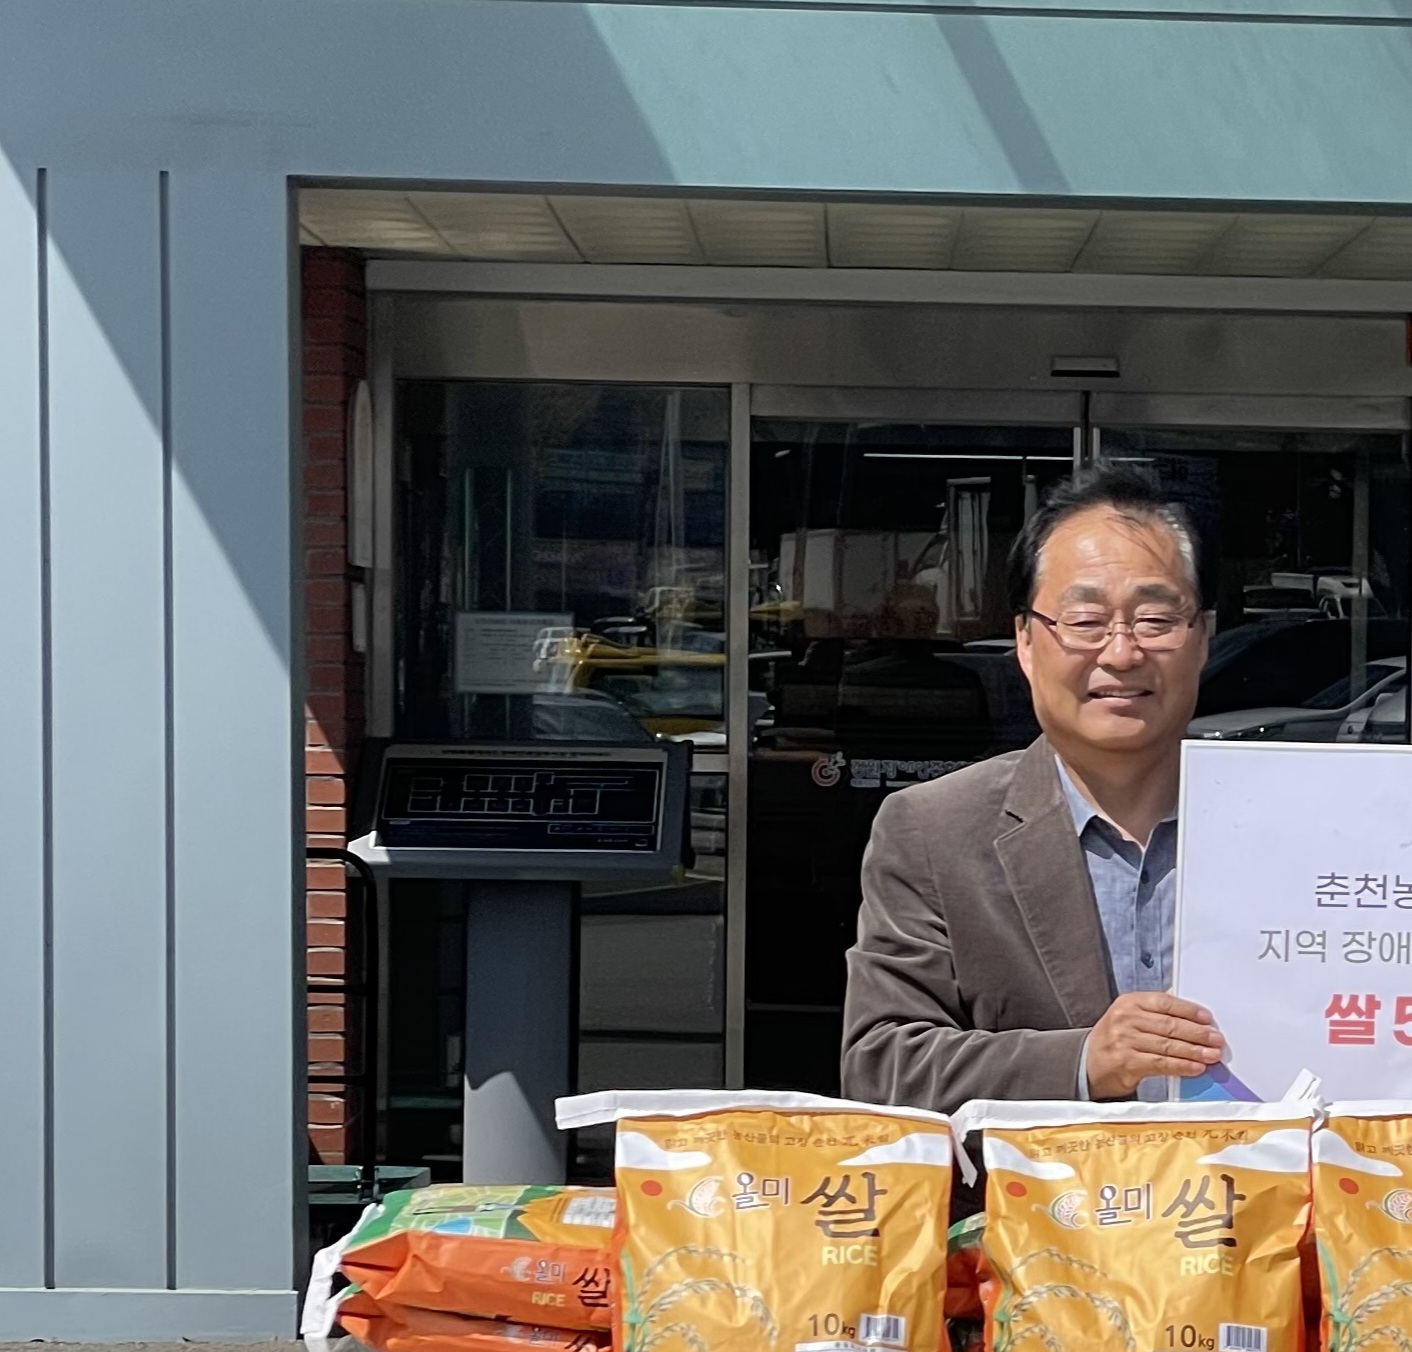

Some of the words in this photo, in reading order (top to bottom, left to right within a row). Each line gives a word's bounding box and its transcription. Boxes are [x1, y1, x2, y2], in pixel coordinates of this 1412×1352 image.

[1258, 928, 1328, 963] 지역
[1324, 993, 1382, 1045] 쌀
[732, 1172, 789, 1209] 올미
[800, 1171, 887, 1237] 쌀
[1095, 1183, 1153, 1226] 올미
[1162, 1174, 1246, 1249] 쌀
[822, 1245, 878, 1266] RICE
[1180, 1254, 1234, 1277] RICE
[534, 1258, 566, 1283] 올미
[572, 1267, 611, 1308] 쌀
[532, 1292, 565, 1307] RICE
[808, 1313, 855, 1338] 10kg
[1165, 1324, 1215, 1350] 10kg
